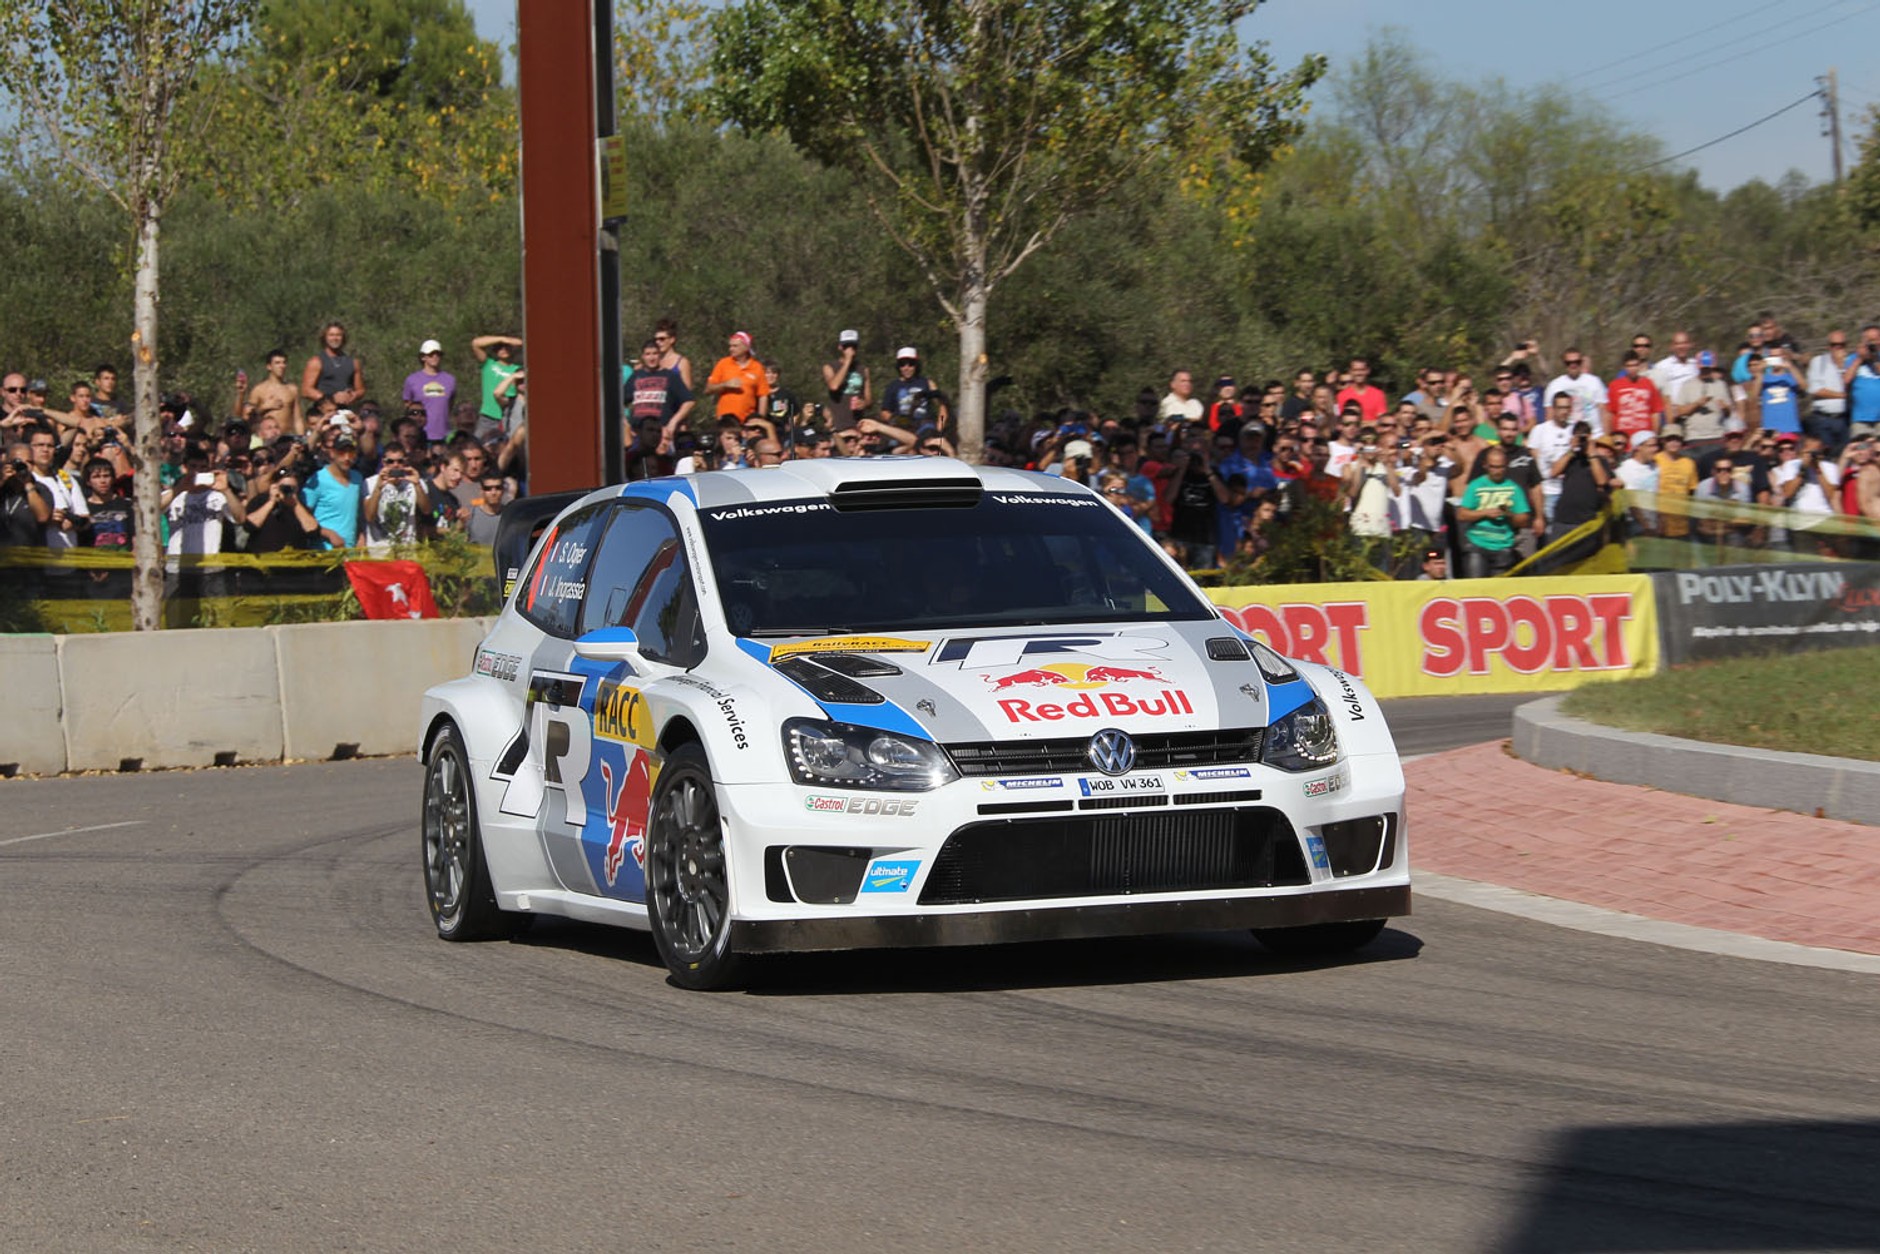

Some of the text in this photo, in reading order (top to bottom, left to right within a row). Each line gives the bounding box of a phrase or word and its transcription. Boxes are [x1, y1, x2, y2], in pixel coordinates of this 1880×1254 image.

[710, 503, 831, 521] Volkswagen
[992, 495, 1099, 507] Volkswagen
[567, 543, 587, 569] Ogier
[555, 577, 586, 604] Ingrassia
[1421, 593, 1633, 677] SPORT
[492, 653, 523, 682] EDGE
[599, 687, 640, 740] RACC
[997, 690, 1194, 723] Red Bull
[717, 698, 749, 750] Services
[1006, 779, 1061, 788] MICHELIN
[1090, 777, 1163, 790] WOB VW 361
[1198, 769, 1249, 778] MICHELIN
[814, 797, 920, 817] Castrol EDGE
[870, 866, 908, 876] ultimate
